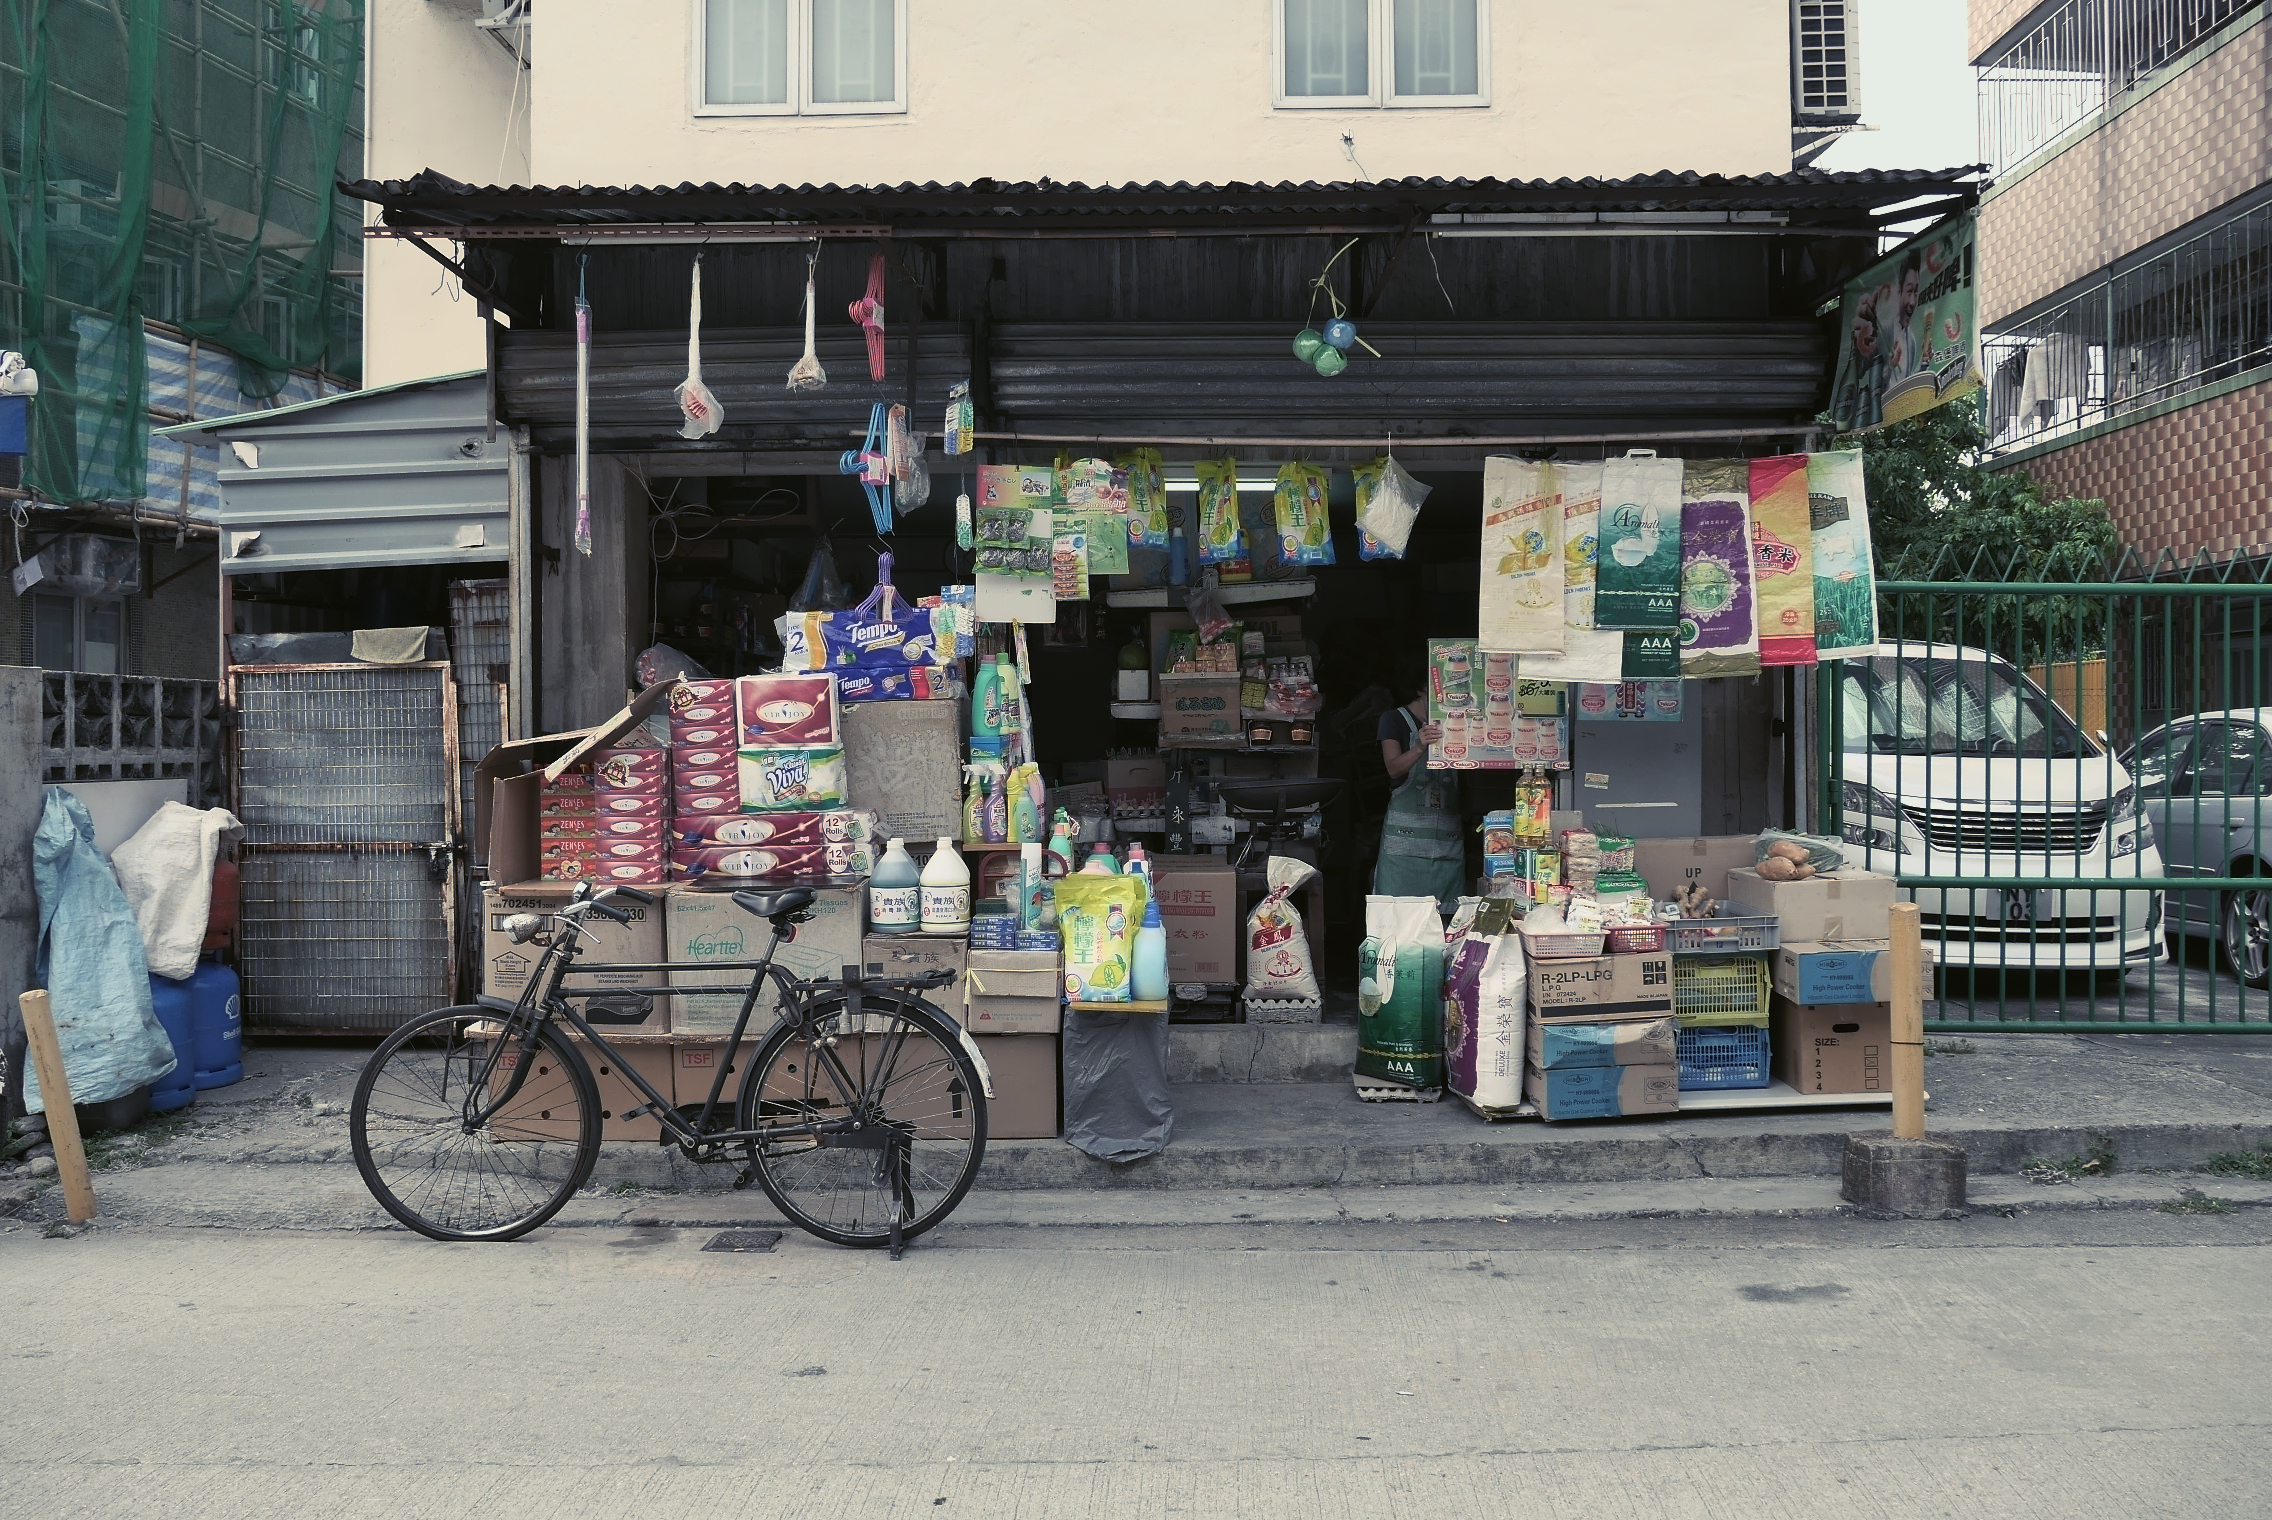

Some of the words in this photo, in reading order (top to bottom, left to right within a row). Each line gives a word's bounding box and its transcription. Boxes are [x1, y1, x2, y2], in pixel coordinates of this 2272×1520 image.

[1759, 544, 1794, 563] 香米
[1648, 598, 1673, 607] AAA
[846, 620, 899, 644] Tempo
[790, 631, 804, 653] 2
[1640, 637, 1673, 648] AAA
[838, 675, 871, 692] Tempo
[934, 674, 943, 690] 2
[560, 777, 584, 786] ZENSES
[767, 765, 805, 795] Viva
[560, 798, 585, 808] ZENSES
[560, 820, 585, 829] ZENSES
[825, 818, 839, 827] 12
[560, 841, 585, 850] ZENSES
[829, 849, 842, 858] 12
[829, 858, 847, 866] Rolls
[1685, 867, 1702, 878] UP
[502, 899, 542, 909] 702451
[883, 897, 906, 906] 貴族
[932, 896, 955, 906] 貴族
[1166, 928, 1206, 940] 衣粉
[1073, 915, 1094, 964] 檸檬王
[1541, 969, 1613, 984] R-2LP-LPG
[1813, 984, 1826, 992] High
[1495, 994, 1513, 1046] 金榮寶
[1814, 1037, 1840, 1047] SIZE:
[1556, 1050, 1570, 1058] High
[1816, 1048, 1820, 1056] 1
[685, 1053, 710, 1064] TSF
[1498, 1050, 1506, 1077] DELUXE
[1816, 1059, 1822, 1068] 2
[1387, 1060, 1415, 1073] AAA
[1565, 1075, 1591, 1083] HIBACHI
[1816, 1071, 1822, 1080] 3
[1816, 1082, 1822, 1091] 4
[1559, 1099, 1572, 1107] High
[1591, 1097, 1611, 1105] Cooker
